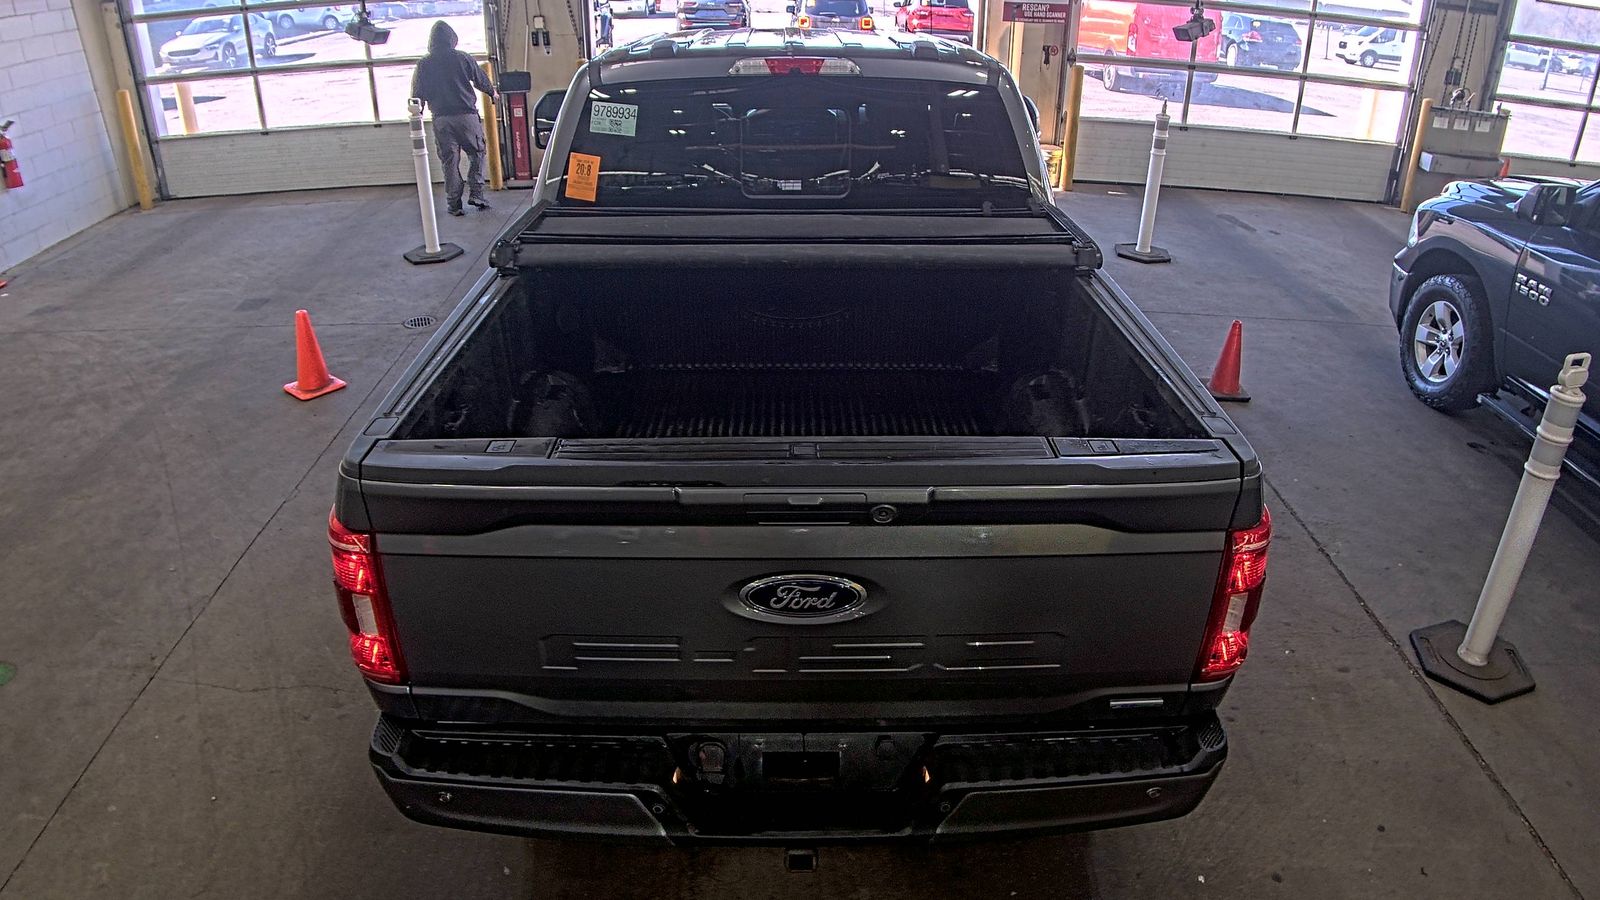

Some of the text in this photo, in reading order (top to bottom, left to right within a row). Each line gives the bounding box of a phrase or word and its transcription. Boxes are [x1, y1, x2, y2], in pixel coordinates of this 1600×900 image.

[1022, 3, 1050, 11] RESCAN?
[593, 104, 637, 120] 9789934
[1515, 282, 1550, 306] 1500
[1516, 273, 1552, 298] RAM
[769, 584, 838, 609] Ford
